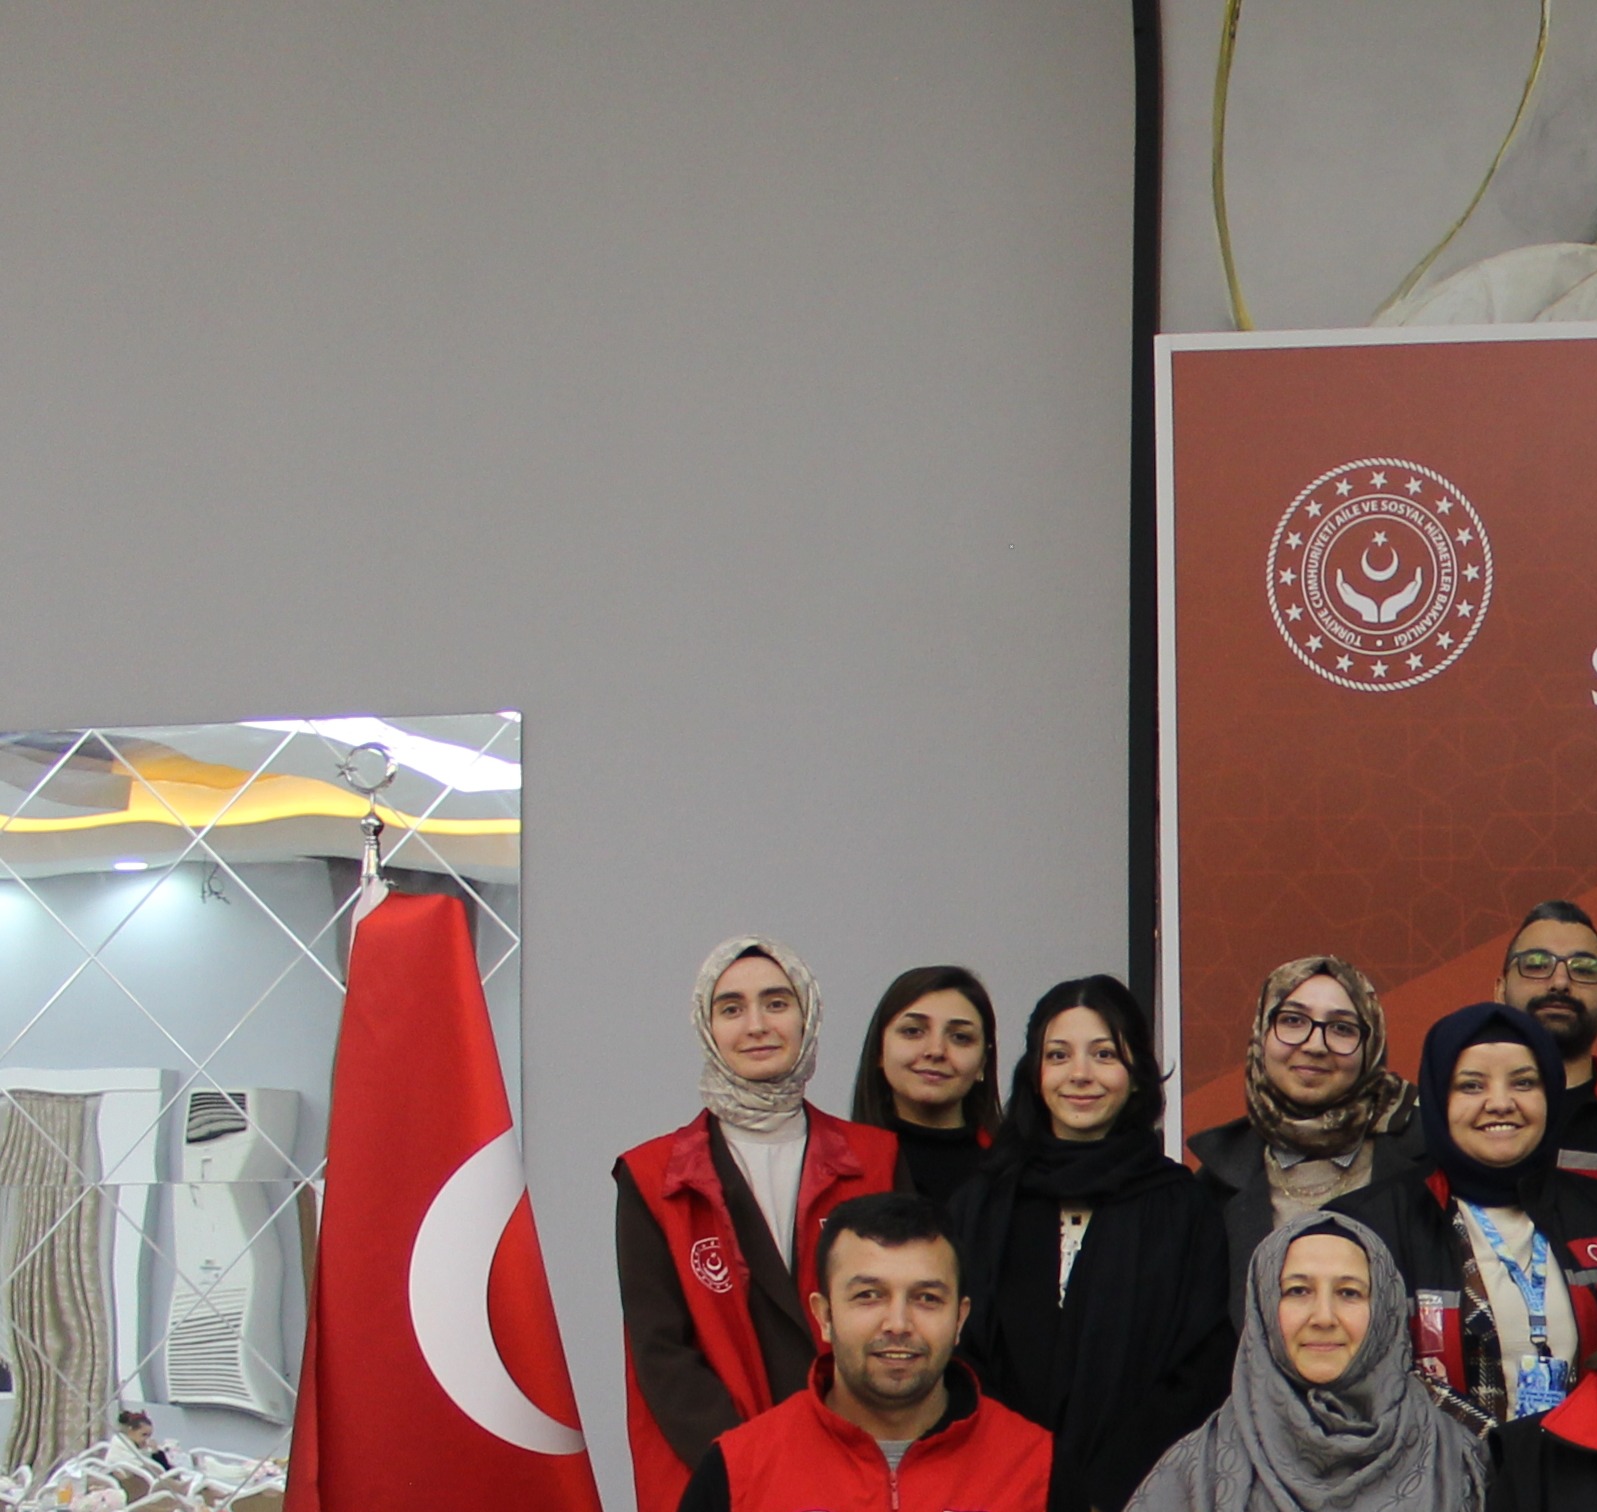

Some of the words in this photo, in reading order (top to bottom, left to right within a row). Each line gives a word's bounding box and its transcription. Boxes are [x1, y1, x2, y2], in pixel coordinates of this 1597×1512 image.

[1336, 504, 1361, 525] AİLE
[1361, 500, 1378, 512] VE
[1381, 500, 1425, 526] SOSYAL
[1307, 521, 1337, 608] CUMHURİYETİ
[1425, 522, 1452, 593] HİZMETLER
[1318, 607, 1362, 647] TÜRKİYE
